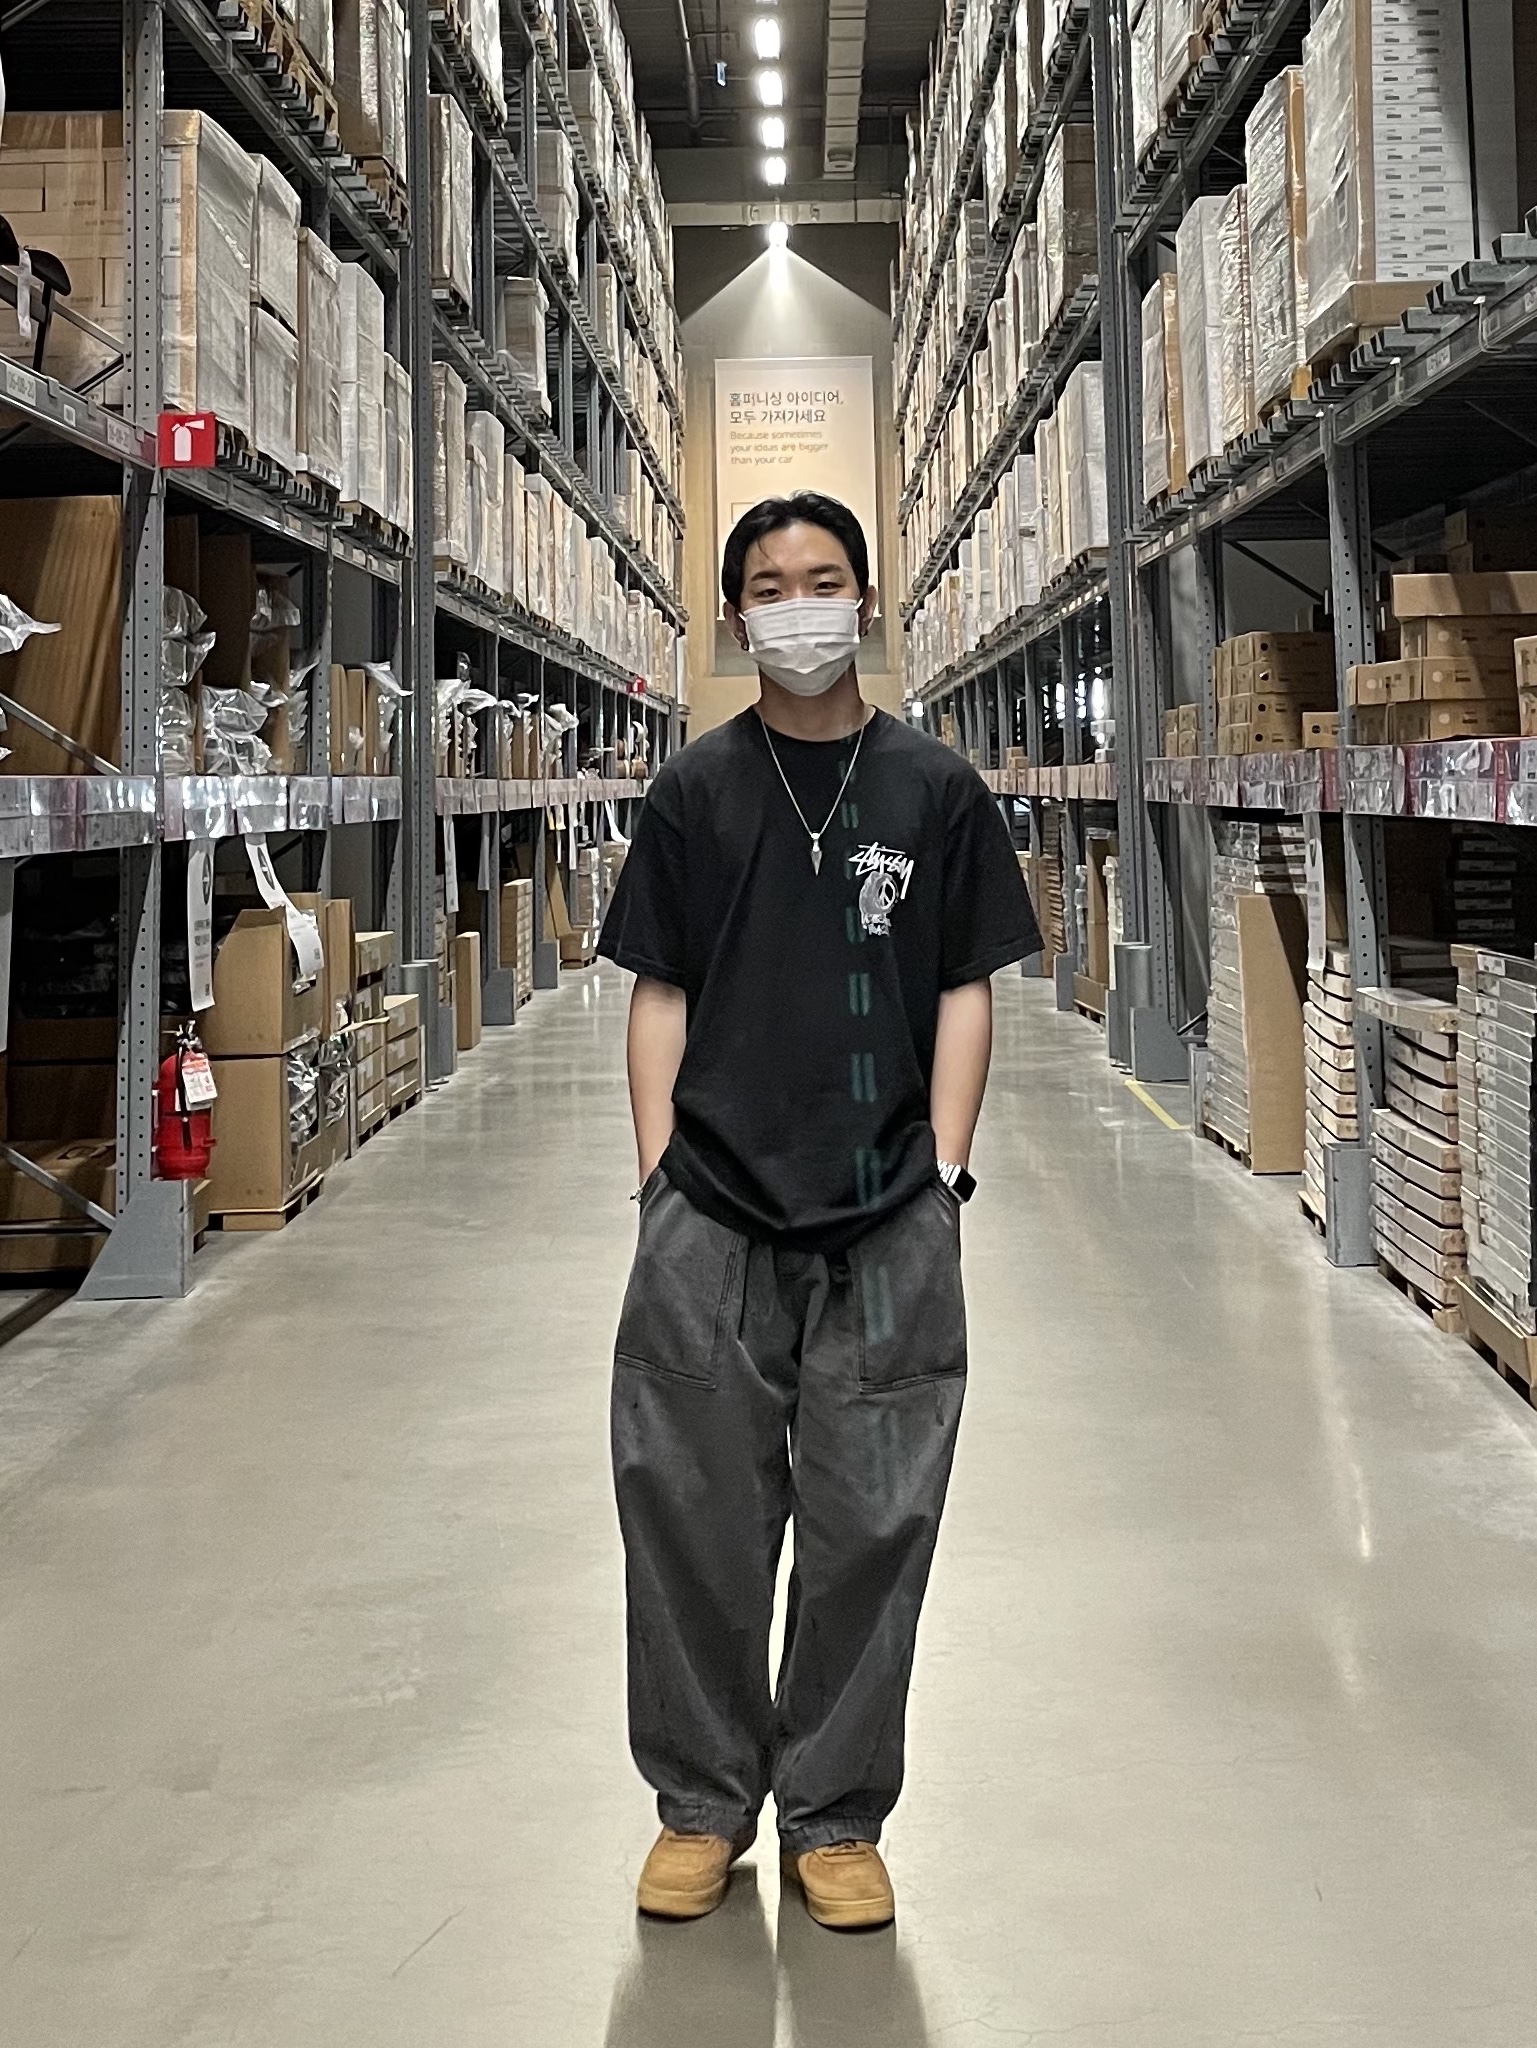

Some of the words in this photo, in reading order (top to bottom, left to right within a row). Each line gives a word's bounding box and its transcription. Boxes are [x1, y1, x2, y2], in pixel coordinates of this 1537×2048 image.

[730, 392, 782, 407] 홈퍼니싱
[786, 390, 844, 405] 아이디어,
[730, 410, 757, 425] 모두
[730, 431, 769, 440] Because
[771, 431, 823, 440] sometimes
[730, 444, 752, 454] your
[754, 443, 779, 452] ideas
[780, 444, 796, 452] are
[798, 442, 829, 453] bigger
[730, 456, 752, 465] than
[755, 457, 776, 466] your
[778, 455, 793, 464] car
